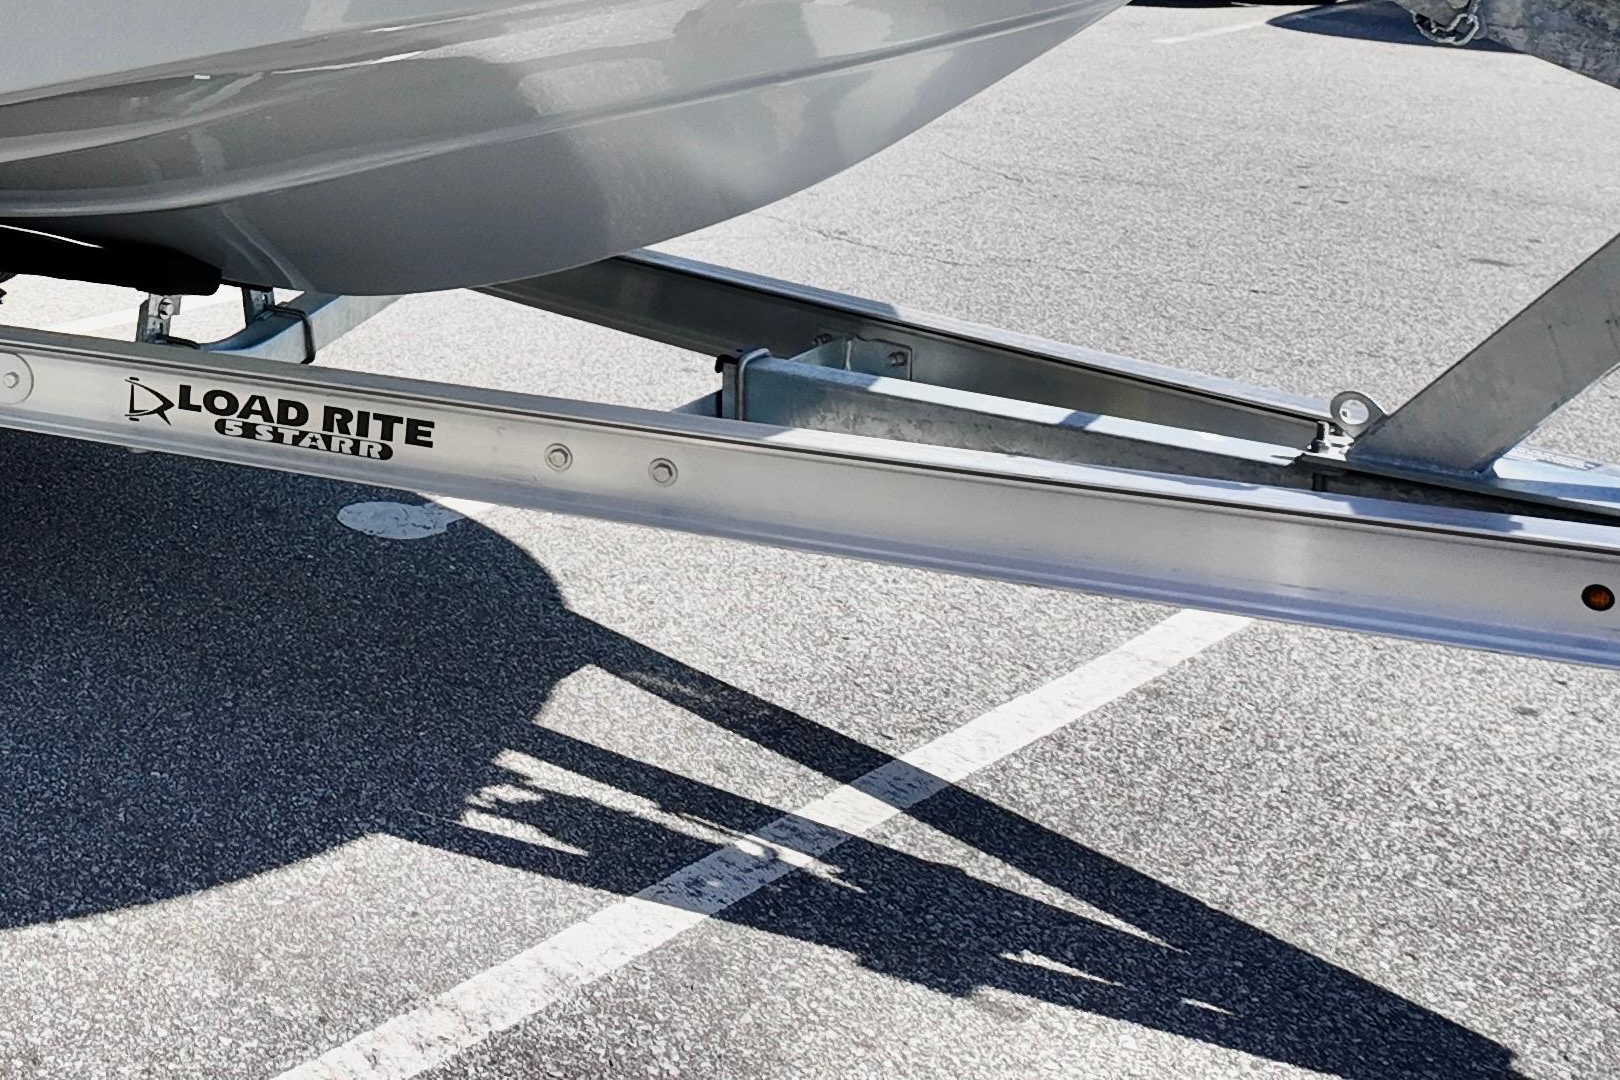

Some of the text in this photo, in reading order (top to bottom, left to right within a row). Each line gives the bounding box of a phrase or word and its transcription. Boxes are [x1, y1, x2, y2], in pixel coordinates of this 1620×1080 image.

[178, 384, 435, 448] LOAD RITE
[224, 420, 384, 460] 5 STARR
